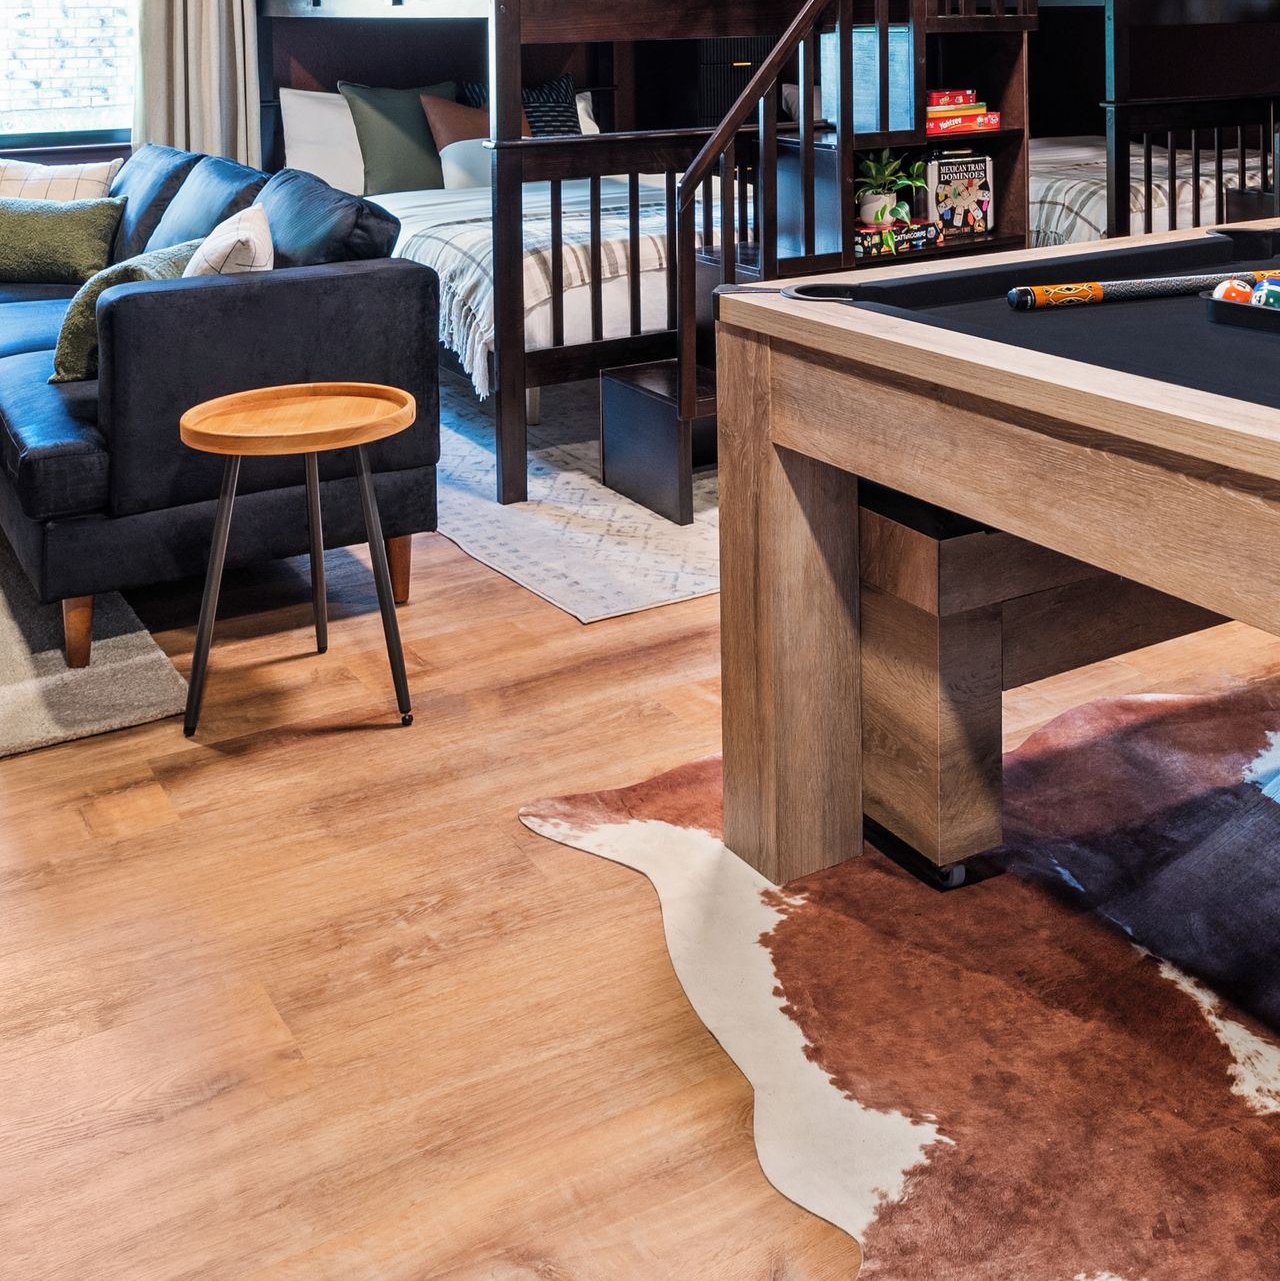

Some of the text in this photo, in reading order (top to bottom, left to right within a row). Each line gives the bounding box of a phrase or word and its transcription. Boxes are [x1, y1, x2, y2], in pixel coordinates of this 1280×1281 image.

[939, 118, 962, 131] Yahtzee
[940, 162, 985, 174] MEXICAN TRAIN
[941, 170, 985, 181] DOMINOES
